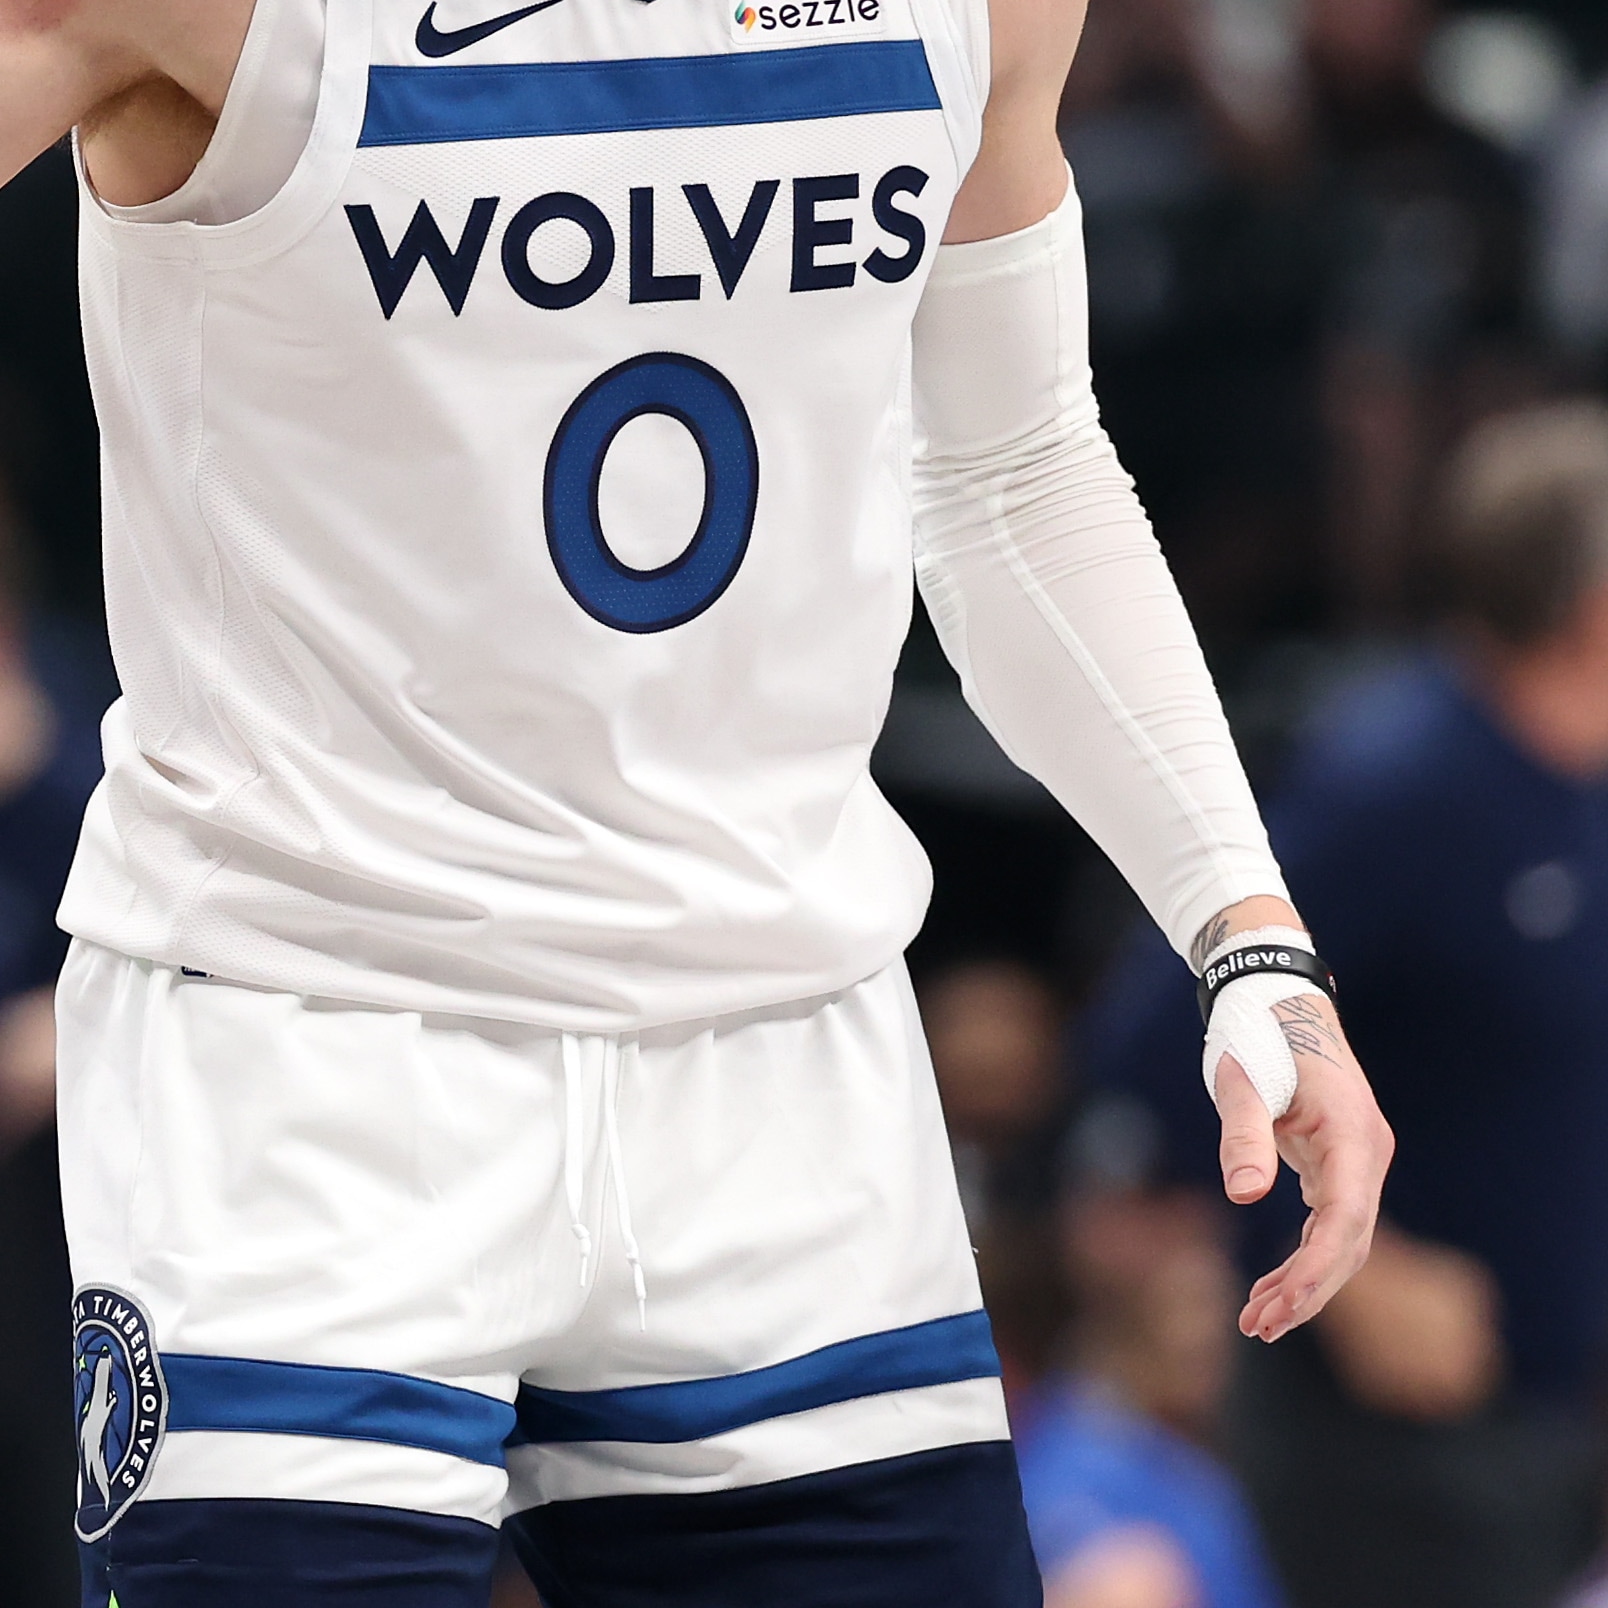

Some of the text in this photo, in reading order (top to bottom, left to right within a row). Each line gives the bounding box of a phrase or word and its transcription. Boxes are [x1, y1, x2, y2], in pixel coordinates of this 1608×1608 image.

[344, 165, 930, 321] WOLVES
[543, 352, 760, 635] 0
[1205, 950, 1292, 990] Believe
[94, 1296, 157, 1488] TIMBERWOLVES
